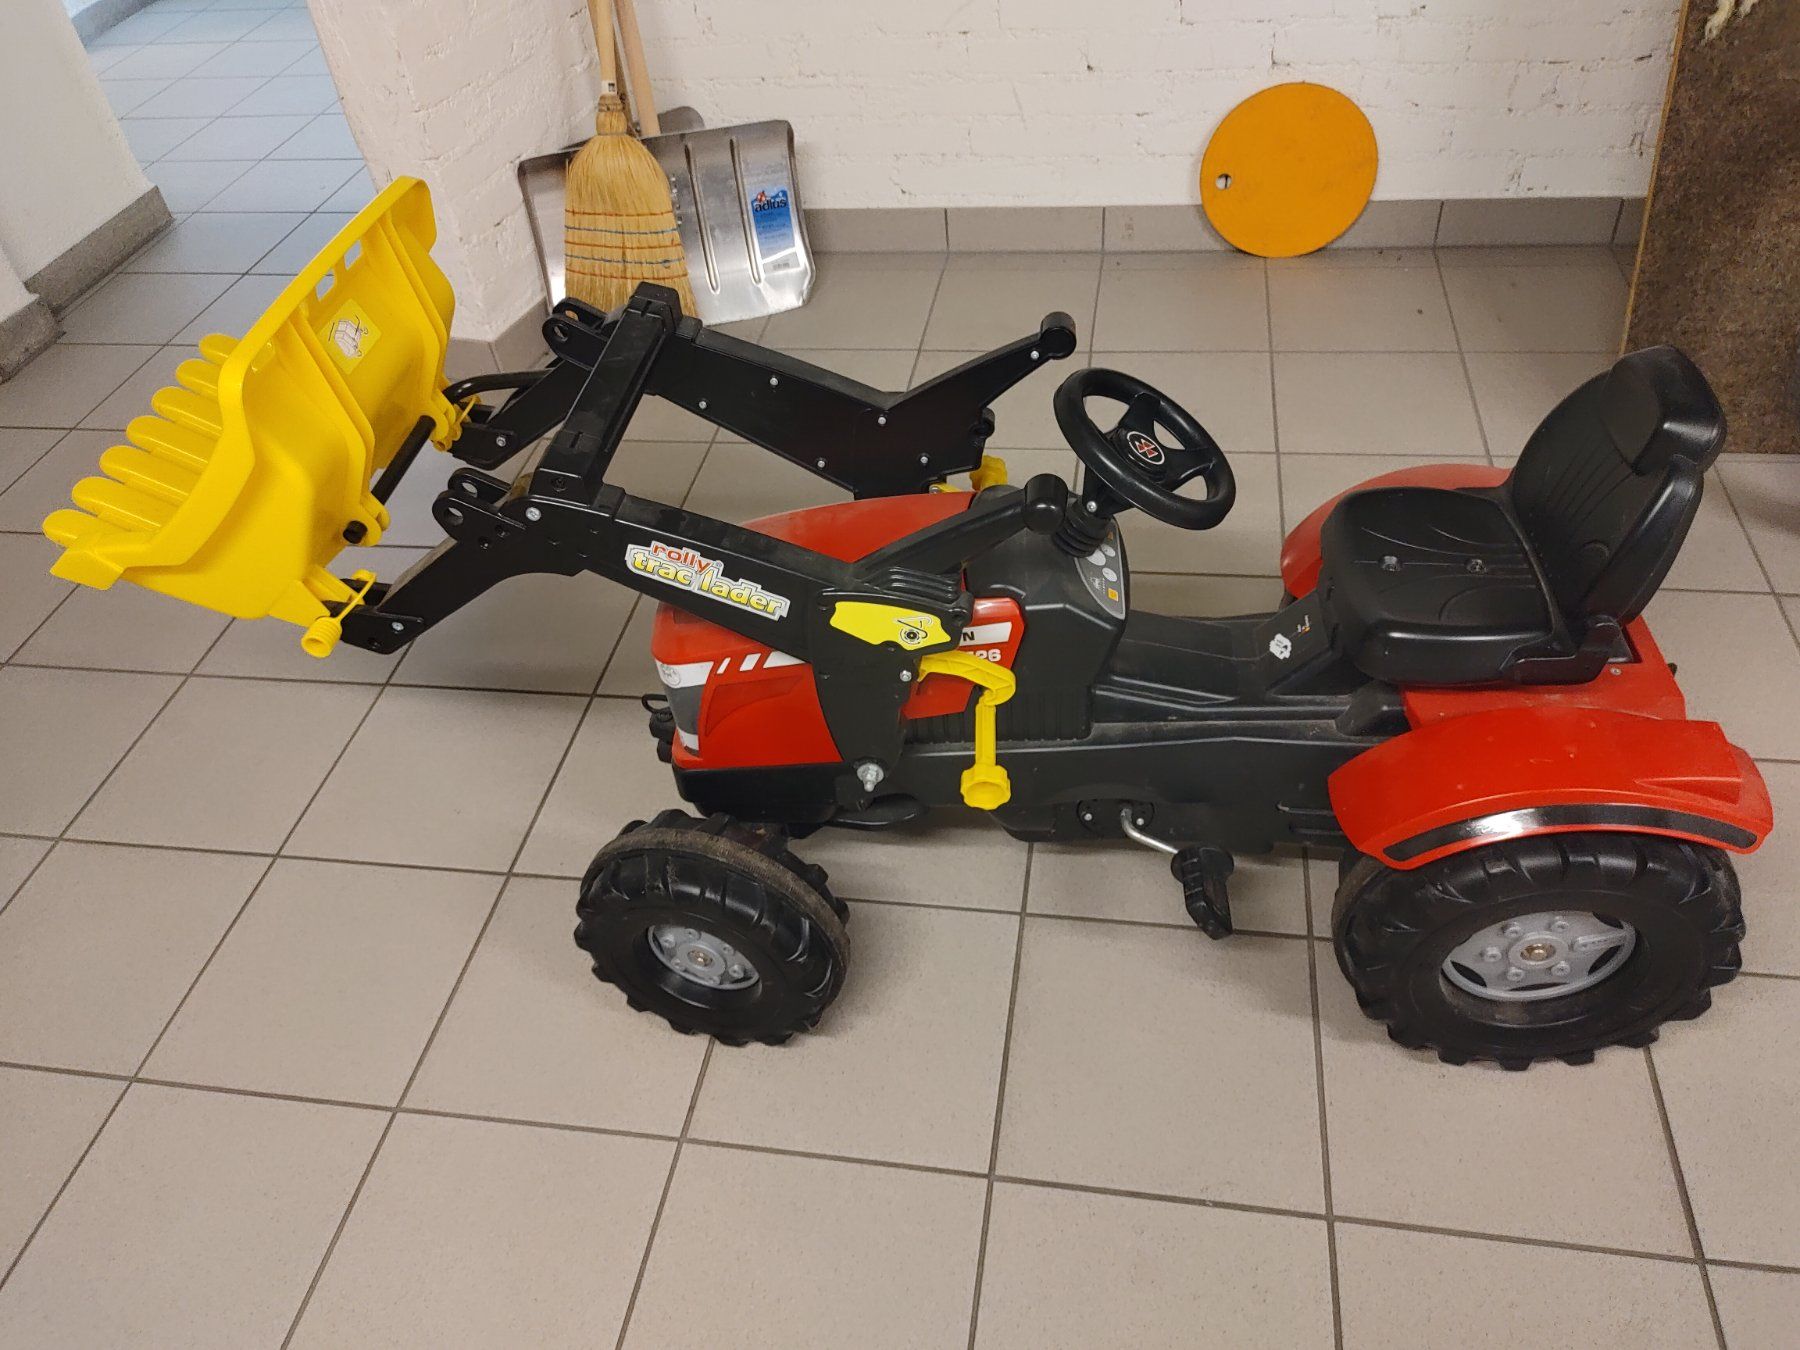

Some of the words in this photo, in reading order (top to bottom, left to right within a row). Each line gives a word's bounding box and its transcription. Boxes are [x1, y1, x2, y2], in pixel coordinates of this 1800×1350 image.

[653, 544, 712, 573] rolly
[633, 551, 693, 585] trac
[700, 569, 784, 613] lader
